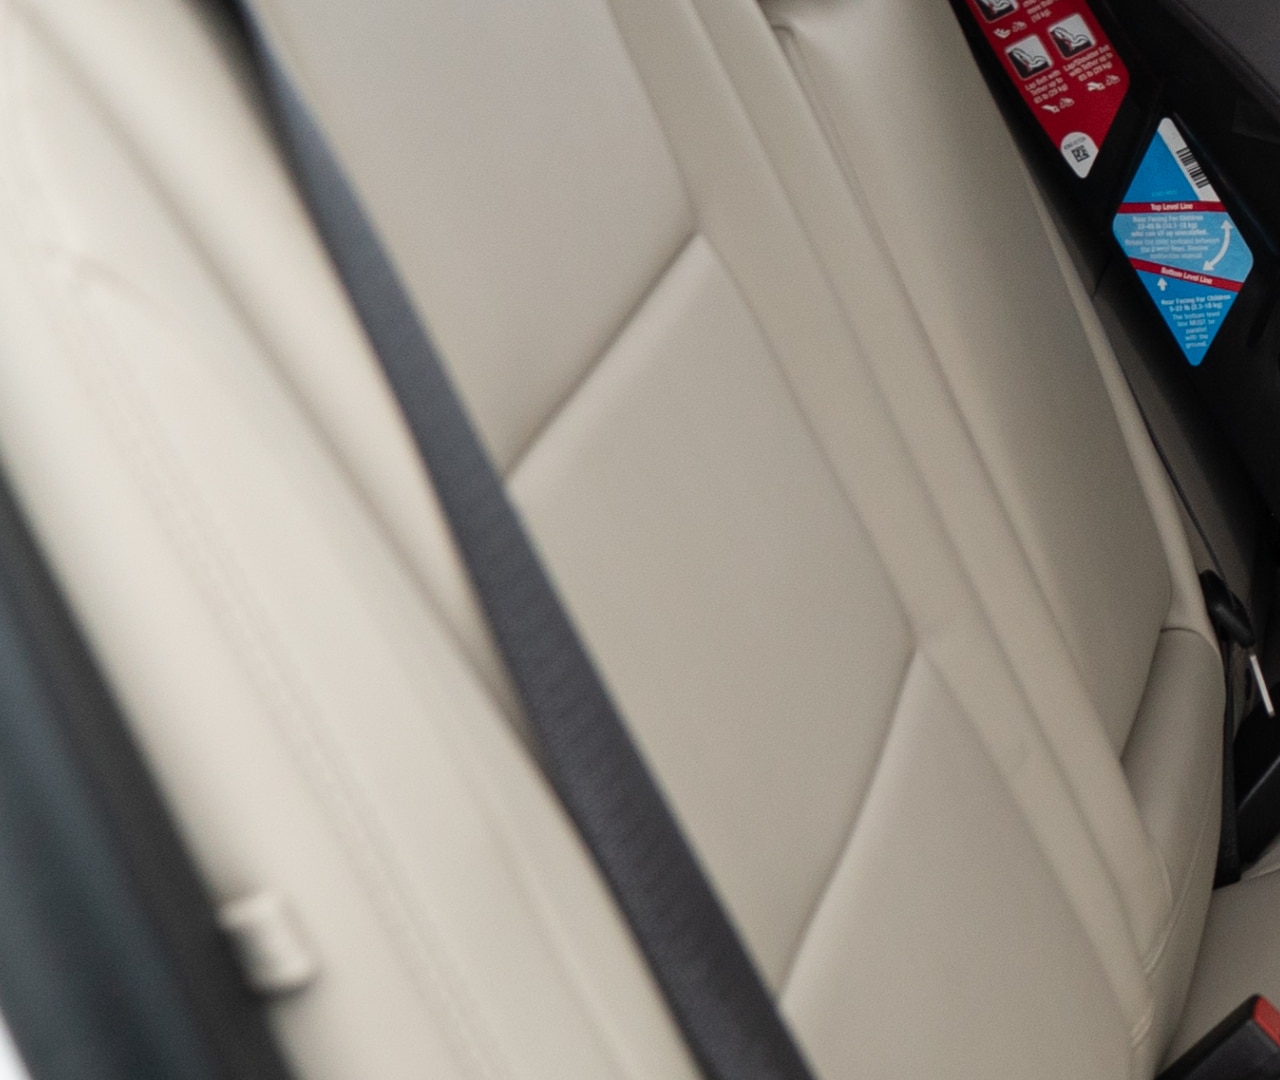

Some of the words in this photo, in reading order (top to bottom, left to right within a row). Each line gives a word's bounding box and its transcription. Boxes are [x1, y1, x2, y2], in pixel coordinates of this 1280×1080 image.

[1081, 59, 1098, 70] Tether
[1025, 82, 1037, 90] Lap
[1036, 76, 1048, 85] Belt
[1030, 85, 1048, 96] Tether
[1161, 267, 1183, 278] Bottom
[1183, 272, 1200, 281] Level
[1200, 275, 1213, 284] Line
